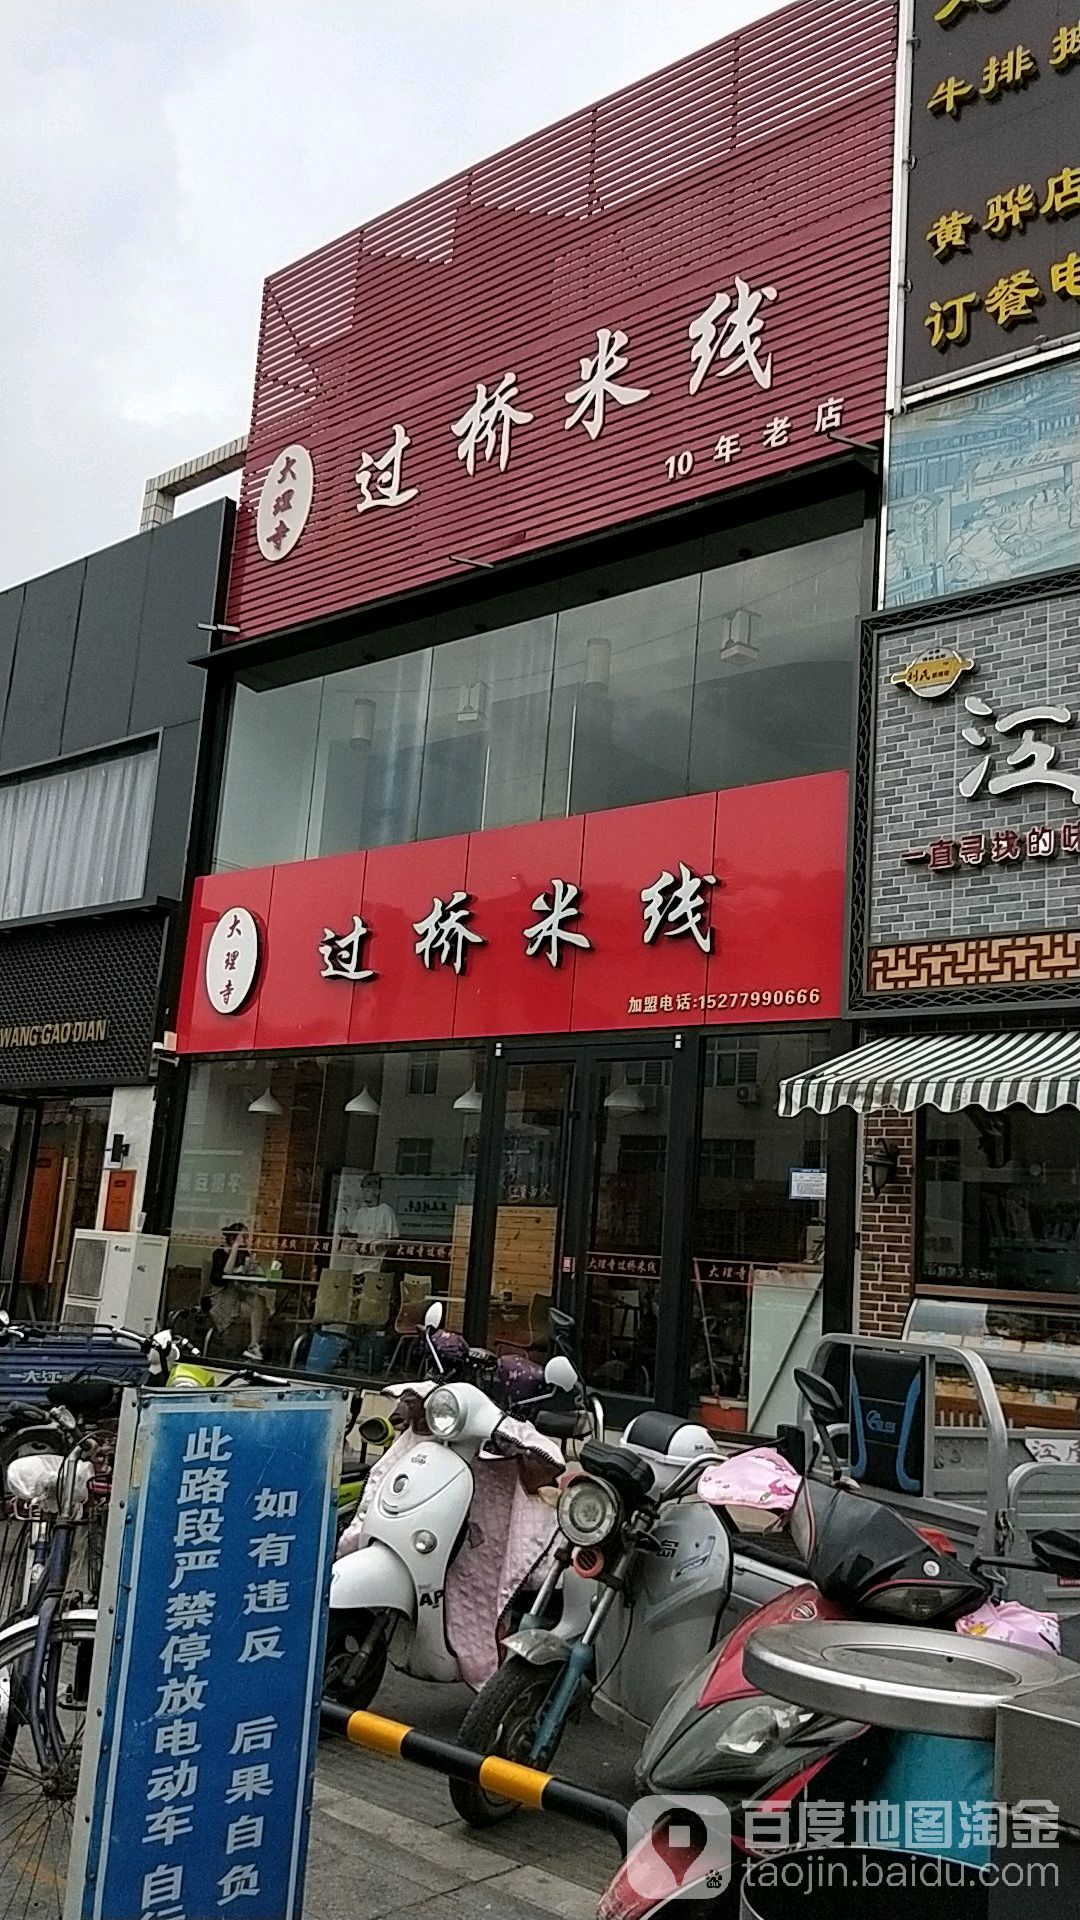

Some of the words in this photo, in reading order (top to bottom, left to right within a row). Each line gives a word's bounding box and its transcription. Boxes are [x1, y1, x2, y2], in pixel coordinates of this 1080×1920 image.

[925, 167, 1080, 258] 黄骅店
[355, 276, 779, 515] 过桥米线
[664, 396, 845, 480] 10年老店
[266, 456, 297, 551] 大理寺
[958, 696, 1080, 805] 江
[219, 914, 242, 1005] 大理寺
[318, 861, 718, 982] 过桥米线
[627, 988, 821, 1014] 加盟电话:15277990666
[587, 1257, 656, 1274] 大理寺过桥米线
[237, 1487, 299, 1663] 如有违反
[217, 1714, 279, 1907] 后果自负
